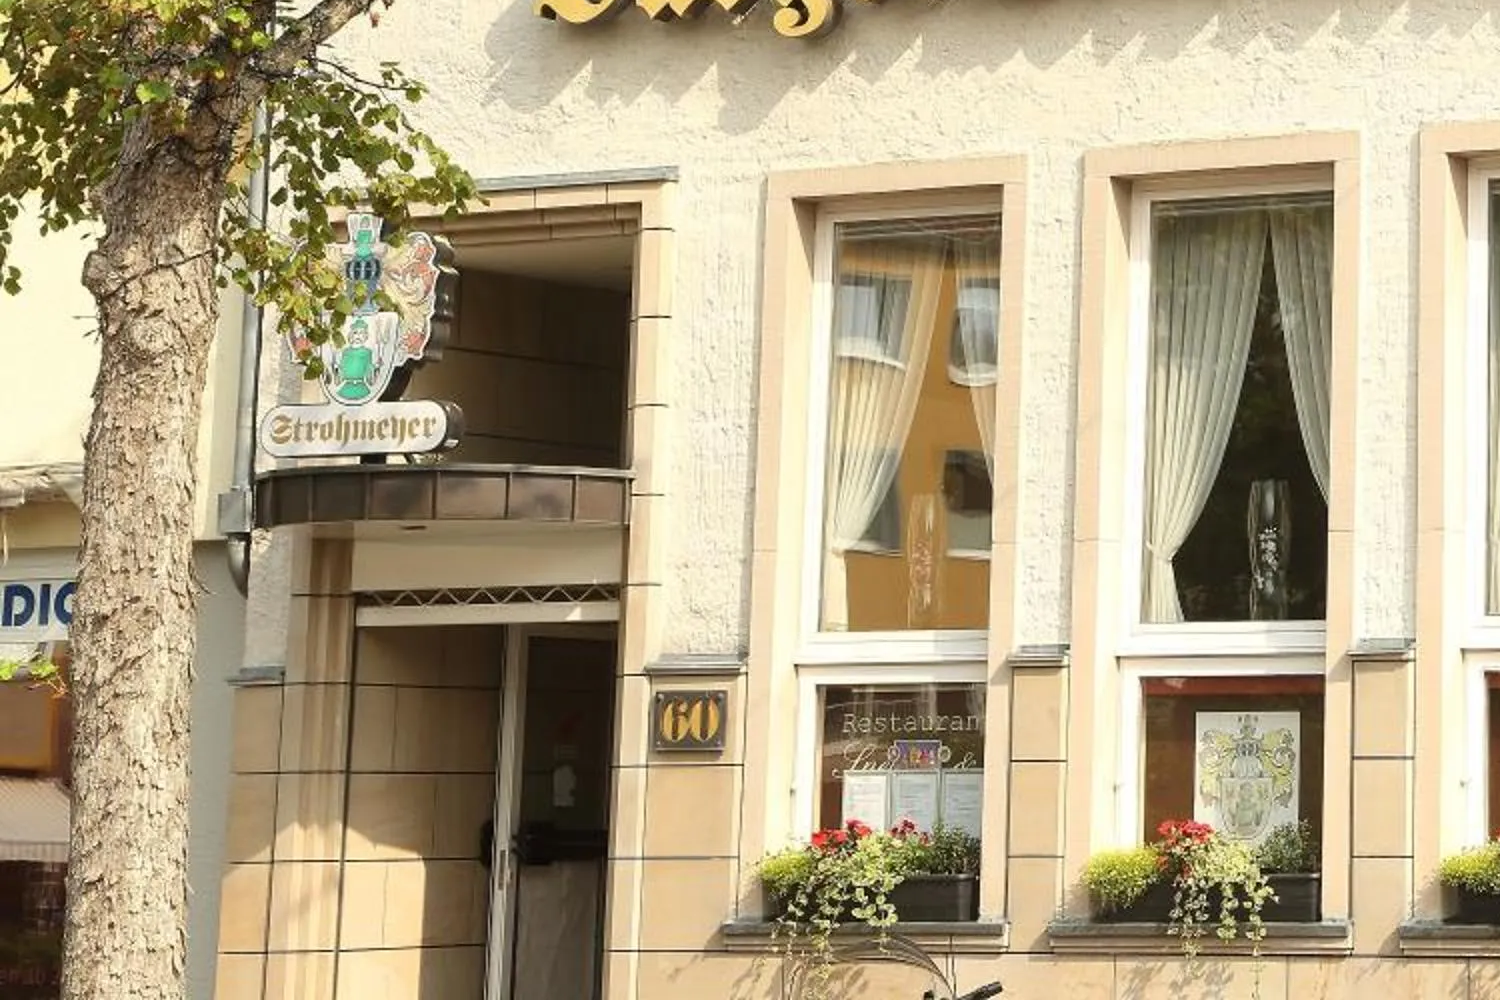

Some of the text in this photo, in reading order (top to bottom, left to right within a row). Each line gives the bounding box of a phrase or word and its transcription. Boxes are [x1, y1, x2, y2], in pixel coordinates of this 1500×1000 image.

[270, 412, 437, 448] Strohmeyer
[660, 697, 720, 742] 60
[842, 712, 984, 733] Restauran
